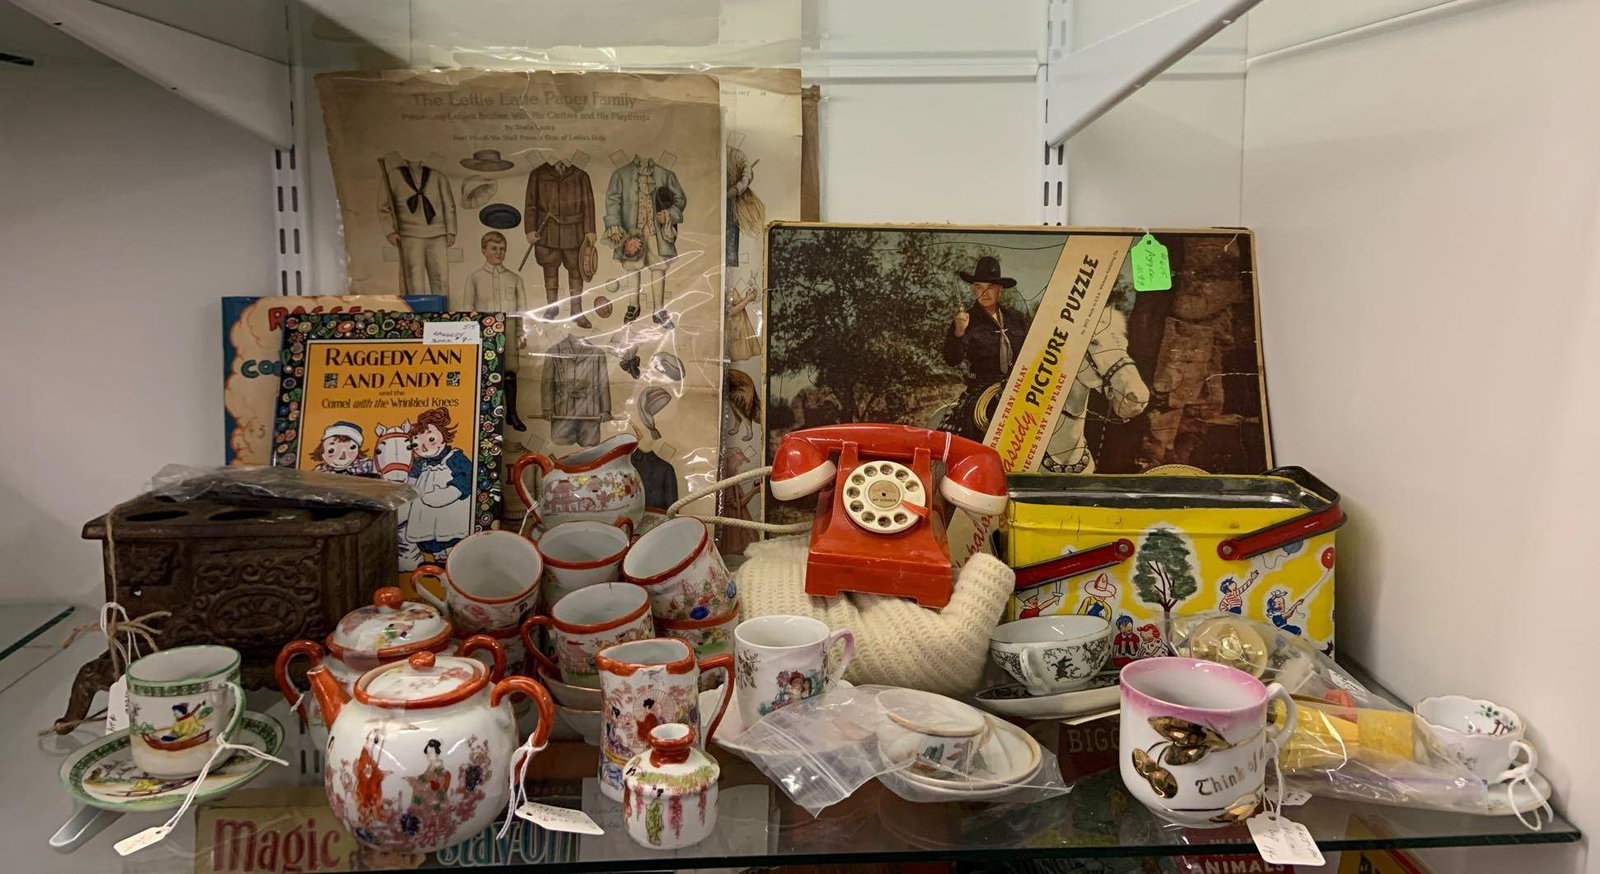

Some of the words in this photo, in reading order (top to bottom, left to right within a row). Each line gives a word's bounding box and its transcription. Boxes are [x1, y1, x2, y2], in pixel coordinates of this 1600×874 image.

[411, 93, 442, 106] The
[449, 91, 494, 106] Lettie
[592, 91, 638, 109] Family
[1025, 326, 1069, 407] PICTURE
[1060, 254, 1099, 323] PUZZLE
[325, 347, 418, 366] RAGGEDY
[420, 347, 462, 365] ANN
[342, 372, 385, 389] AND
[388, 370, 443, 388] ANDY
[322, 398, 351, 410] Camel
[353, 397, 373, 409] with
[374, 397, 389, 409] the
[390, 396, 429, 408] Wrinkled
[431, 396, 459, 408] Knees
[990, 395, 1016, 449] RAME-TRAY
[1013, 365, 1028, 393] INLAY
[1035, 417, 1048, 441] STAY
[1045, 404, 1053, 416] IN
[1051, 373, 1067, 402] PLACE
[1003, 410, 1038, 473] assidy
[1194, 766, 1245, 796] Think
